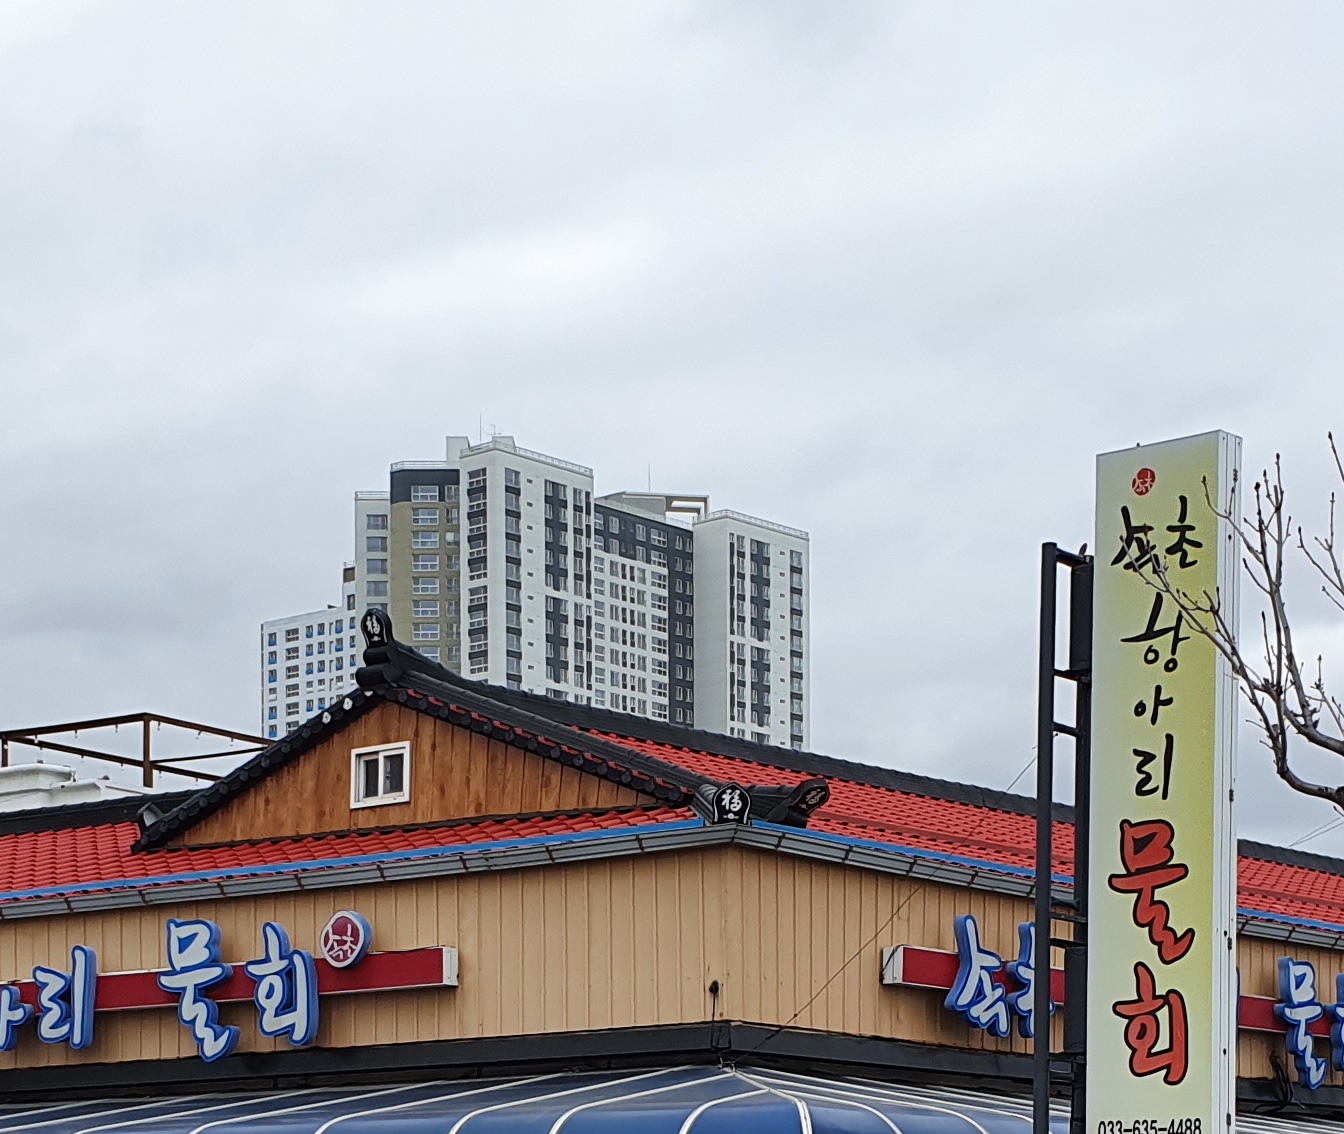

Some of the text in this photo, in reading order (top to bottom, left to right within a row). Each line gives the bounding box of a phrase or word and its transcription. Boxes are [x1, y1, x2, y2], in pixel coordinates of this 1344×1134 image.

[1111, 495, 1203, 575] 속초
[1120, 592, 1190, 800] 항아리
[722, 789, 742, 812] 福
[158, 918, 320, 1063] 물회
[1108, 819, 1195, 1086] 물회
